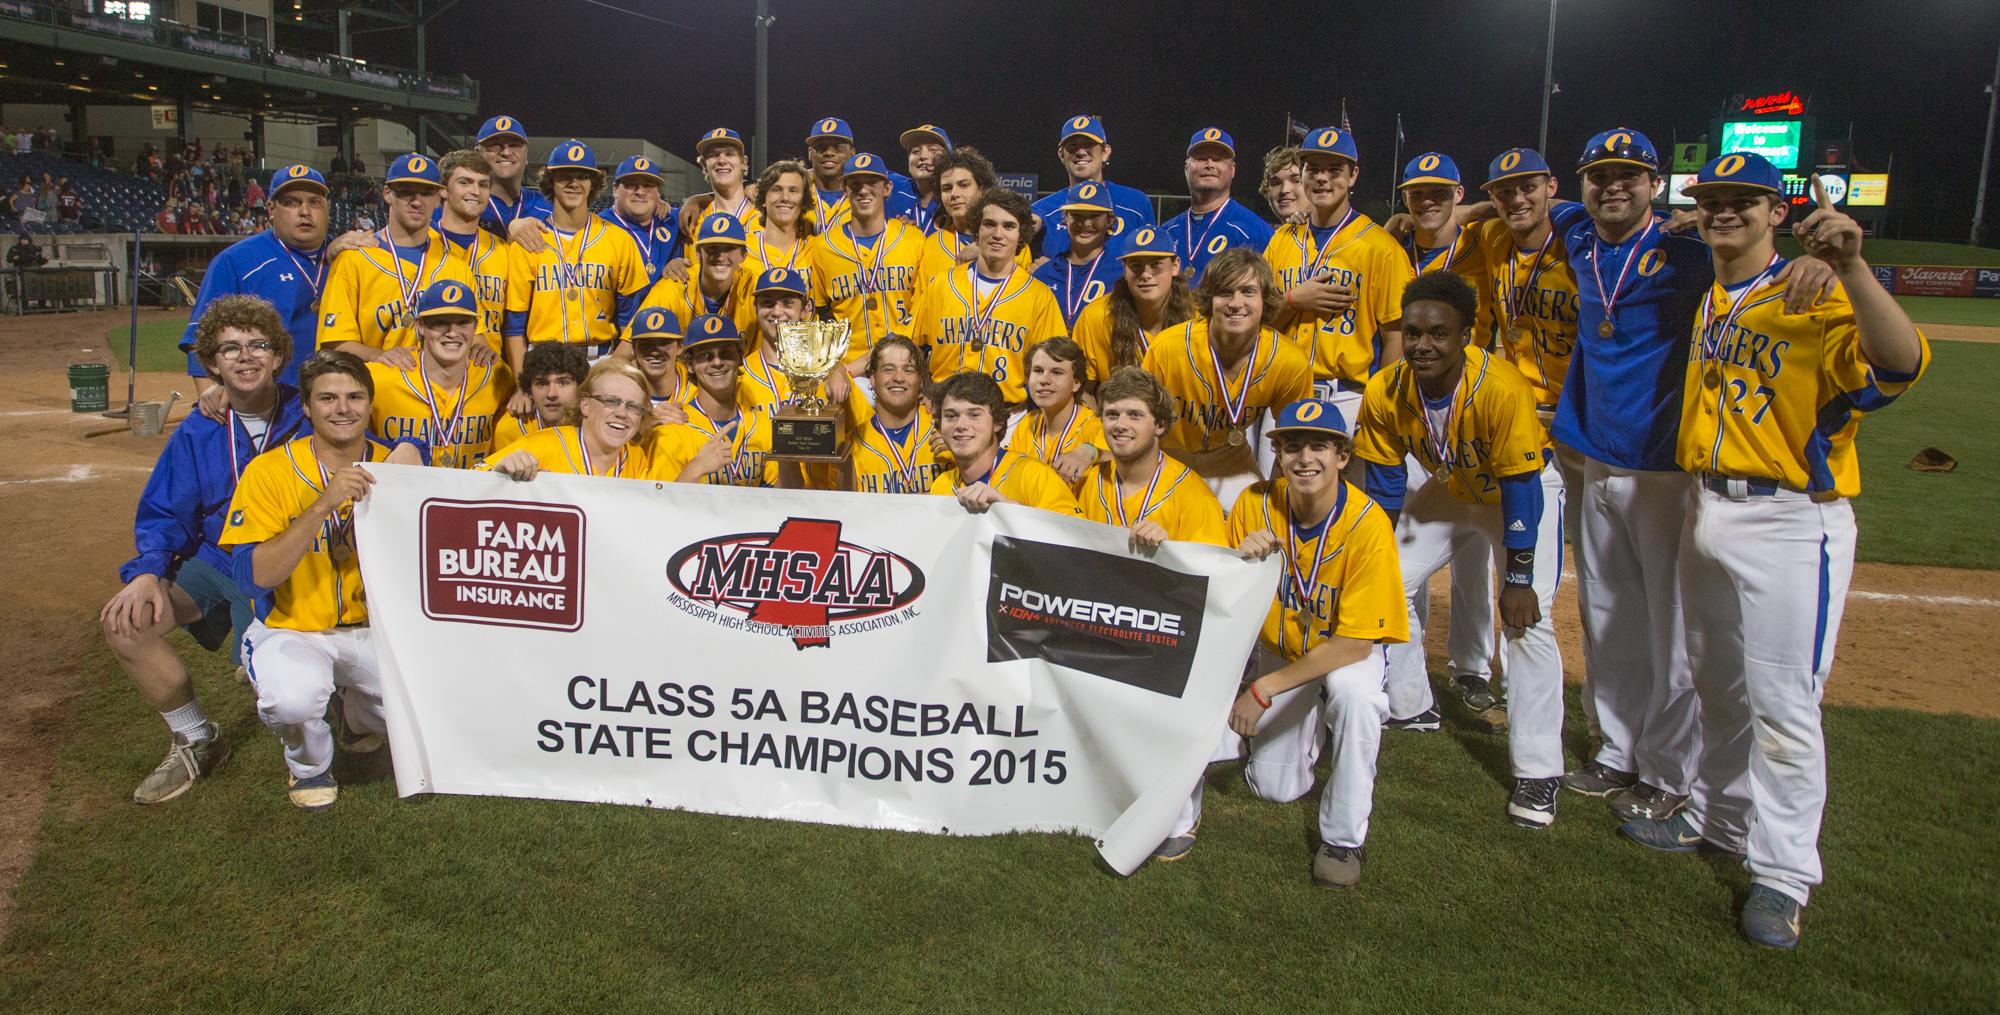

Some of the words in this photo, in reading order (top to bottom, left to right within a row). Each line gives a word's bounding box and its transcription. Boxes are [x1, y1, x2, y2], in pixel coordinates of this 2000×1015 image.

[496, 118, 511, 131] O
[821, 119, 837, 133] O
[1073, 116, 1089, 130] O
[1204, 128, 1221, 141] O
[1318, 131, 1338, 148] O
[568, 145, 584, 161] O
[855, 155, 871, 168] O
[1500, 152, 1520, 171] O
[289, 165, 309, 178] O
[407, 157, 426, 173] O
[635, 158, 650, 171] O
[1419, 155, 1439, 171] O
[1715, 155, 1745, 177] O
[996, 176, 1033, 188] icnic
[1825, 184, 1842, 195] ite
[1079, 184, 1097, 199] O
[712, 216, 730, 233] O
[1136, 229, 1154, 246] O
[1207, 234, 1228, 254] O
[1637, 248, 1667, 276] O
[769, 267, 787, 283] O
[1901, 267, 1969, 281] Havard
[1979, 270, 2000, 282] Pa
[442, 285, 462, 303] O
[646, 312, 664, 330] O
[704, 316, 722, 334] O
[991, 356, 1008, 382] 8
[1728, 377, 1776, 425] 27
[1296, 402, 1323, 422] O
[477, 519, 566, 554] FARM
[438, 548, 566, 584] BUREAU
[691, 543, 897, 608] MHSAA
[456, 585, 566, 611] INSURANCE
[666, 591, 718, 624] MISSISSIPPI
[718, 613, 744, 631] HIGH
[745, 620, 784, 637] SCHOOL
[786, 624, 836, 638] ACTIVITIES
[838, 612, 903, 636] ASSOCIATION,
[902, 604, 921, 621] INC.
[1000, 582, 1182, 636] POWERADE
[1088, 625, 1143, 642] ELECTROLYTE
[1145, 633, 1179, 647] SYSTEM
[567, 675, 715, 719] CLASS
[730, 687, 788, 723] 5A
[800, 690, 1039, 738] BASEBALL
[536, 718, 673, 760] STATE
[686, 729, 955, 784] CHAMPIONS
[968, 748, 1068, 786] 2015
